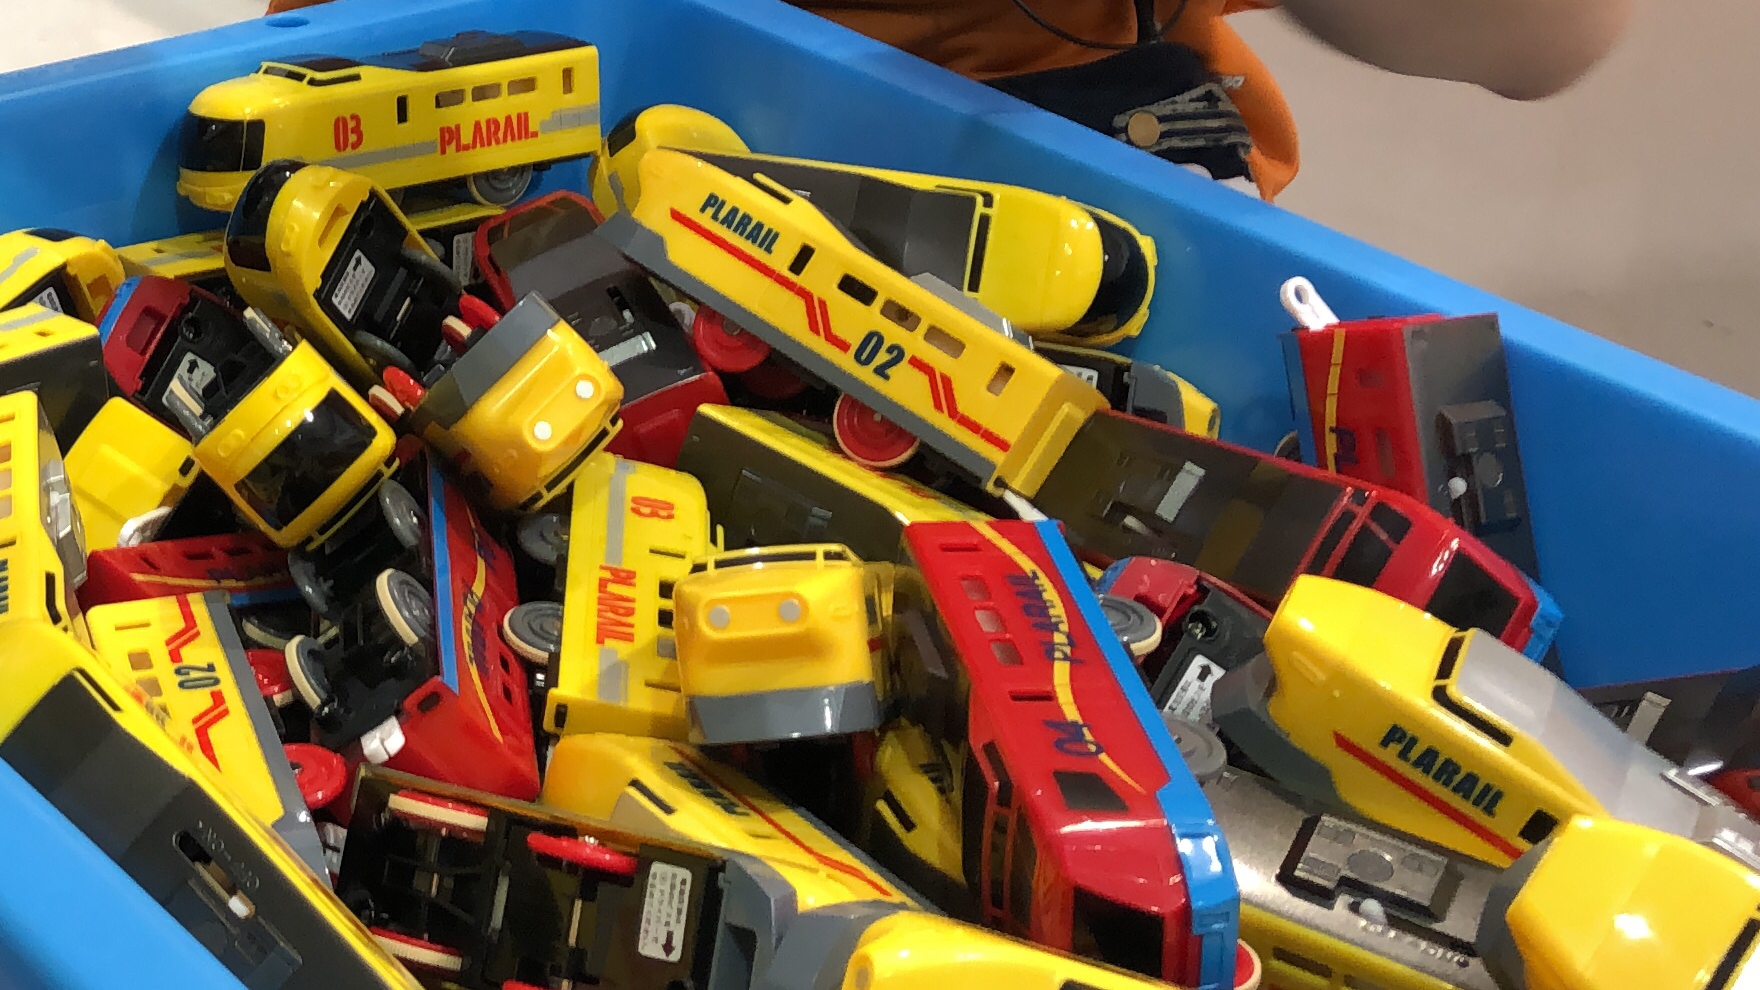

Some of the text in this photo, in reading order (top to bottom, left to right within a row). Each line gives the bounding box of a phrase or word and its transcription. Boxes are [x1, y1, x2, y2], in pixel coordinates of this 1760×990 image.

[333, 112, 539, 155] 03 PLARAIL
[699, 192, 906, 382] PLARAIL 02
[596, 496, 675, 645] 03 PLARAIL
[173, 662, 220, 692] 02
[1380, 723, 1505, 818] PLARAIL
